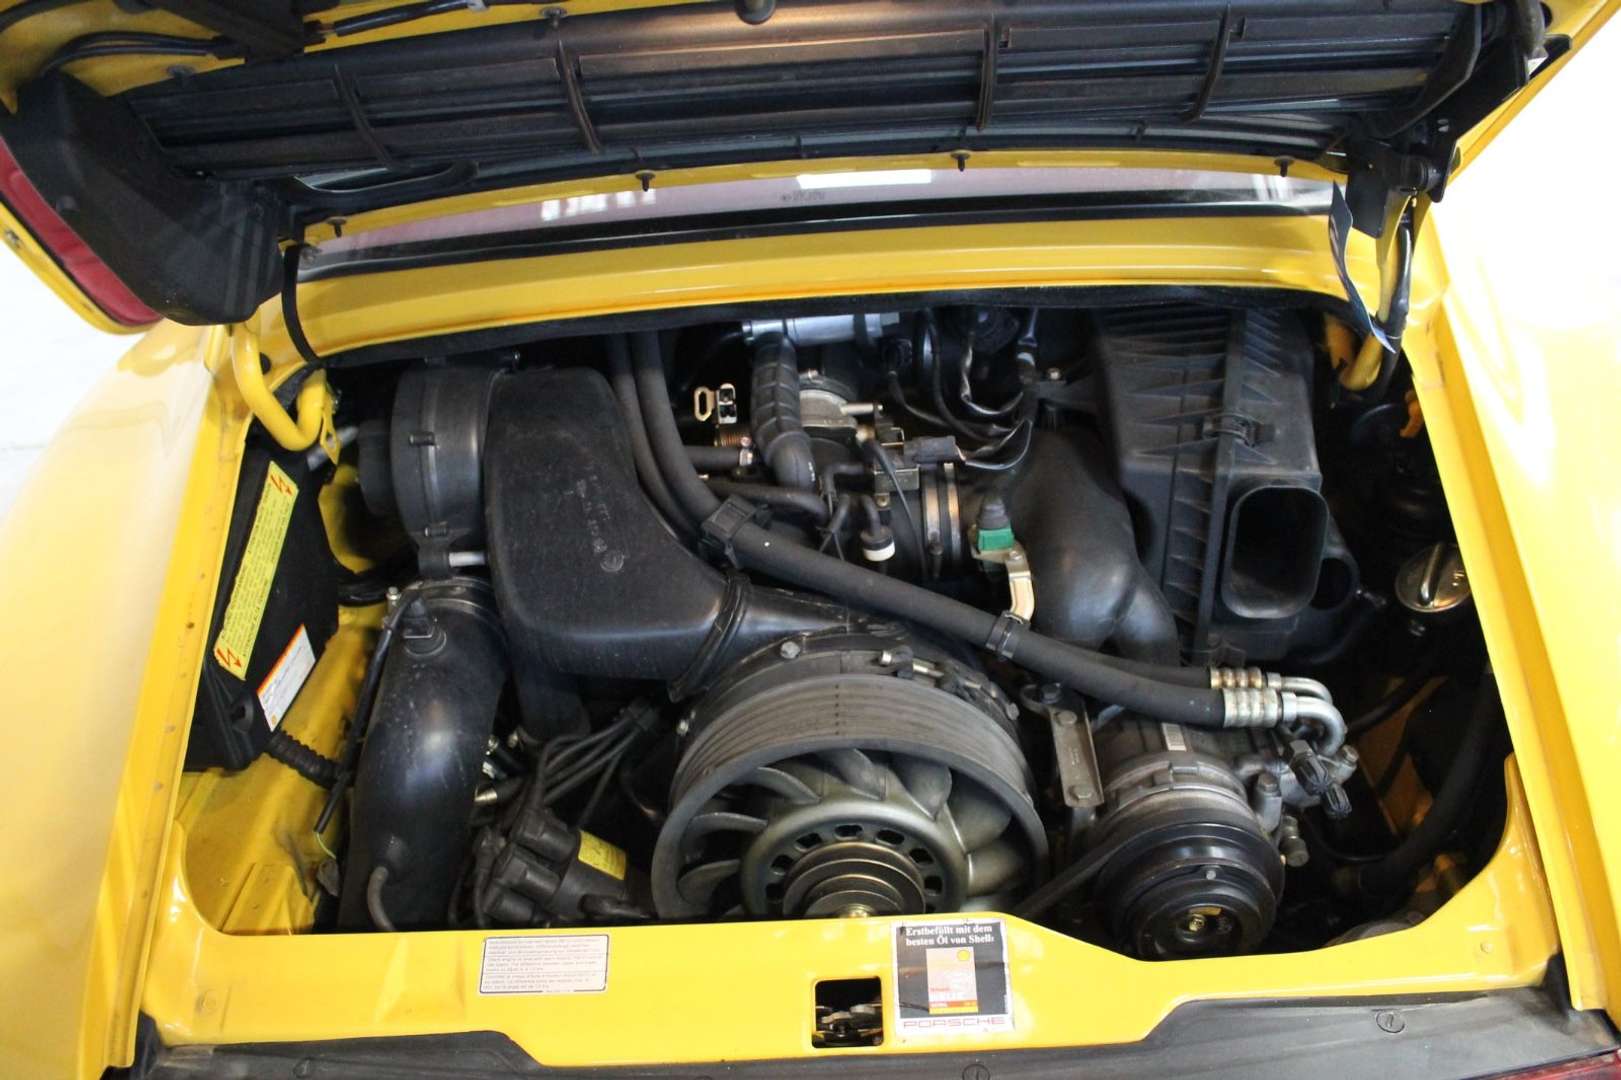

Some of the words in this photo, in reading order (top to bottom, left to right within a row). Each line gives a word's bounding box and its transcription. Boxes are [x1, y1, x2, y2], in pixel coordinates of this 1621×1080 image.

[905, 926, 954, 936] Erstbefüllt
[955, 925, 971, 934] mit
[973, 924, 992, 933] dem
[905, 938, 934, 946] besten
[937, 935, 949, 945] Öl
[903, 1017, 1005, 1028] PORSCHE
